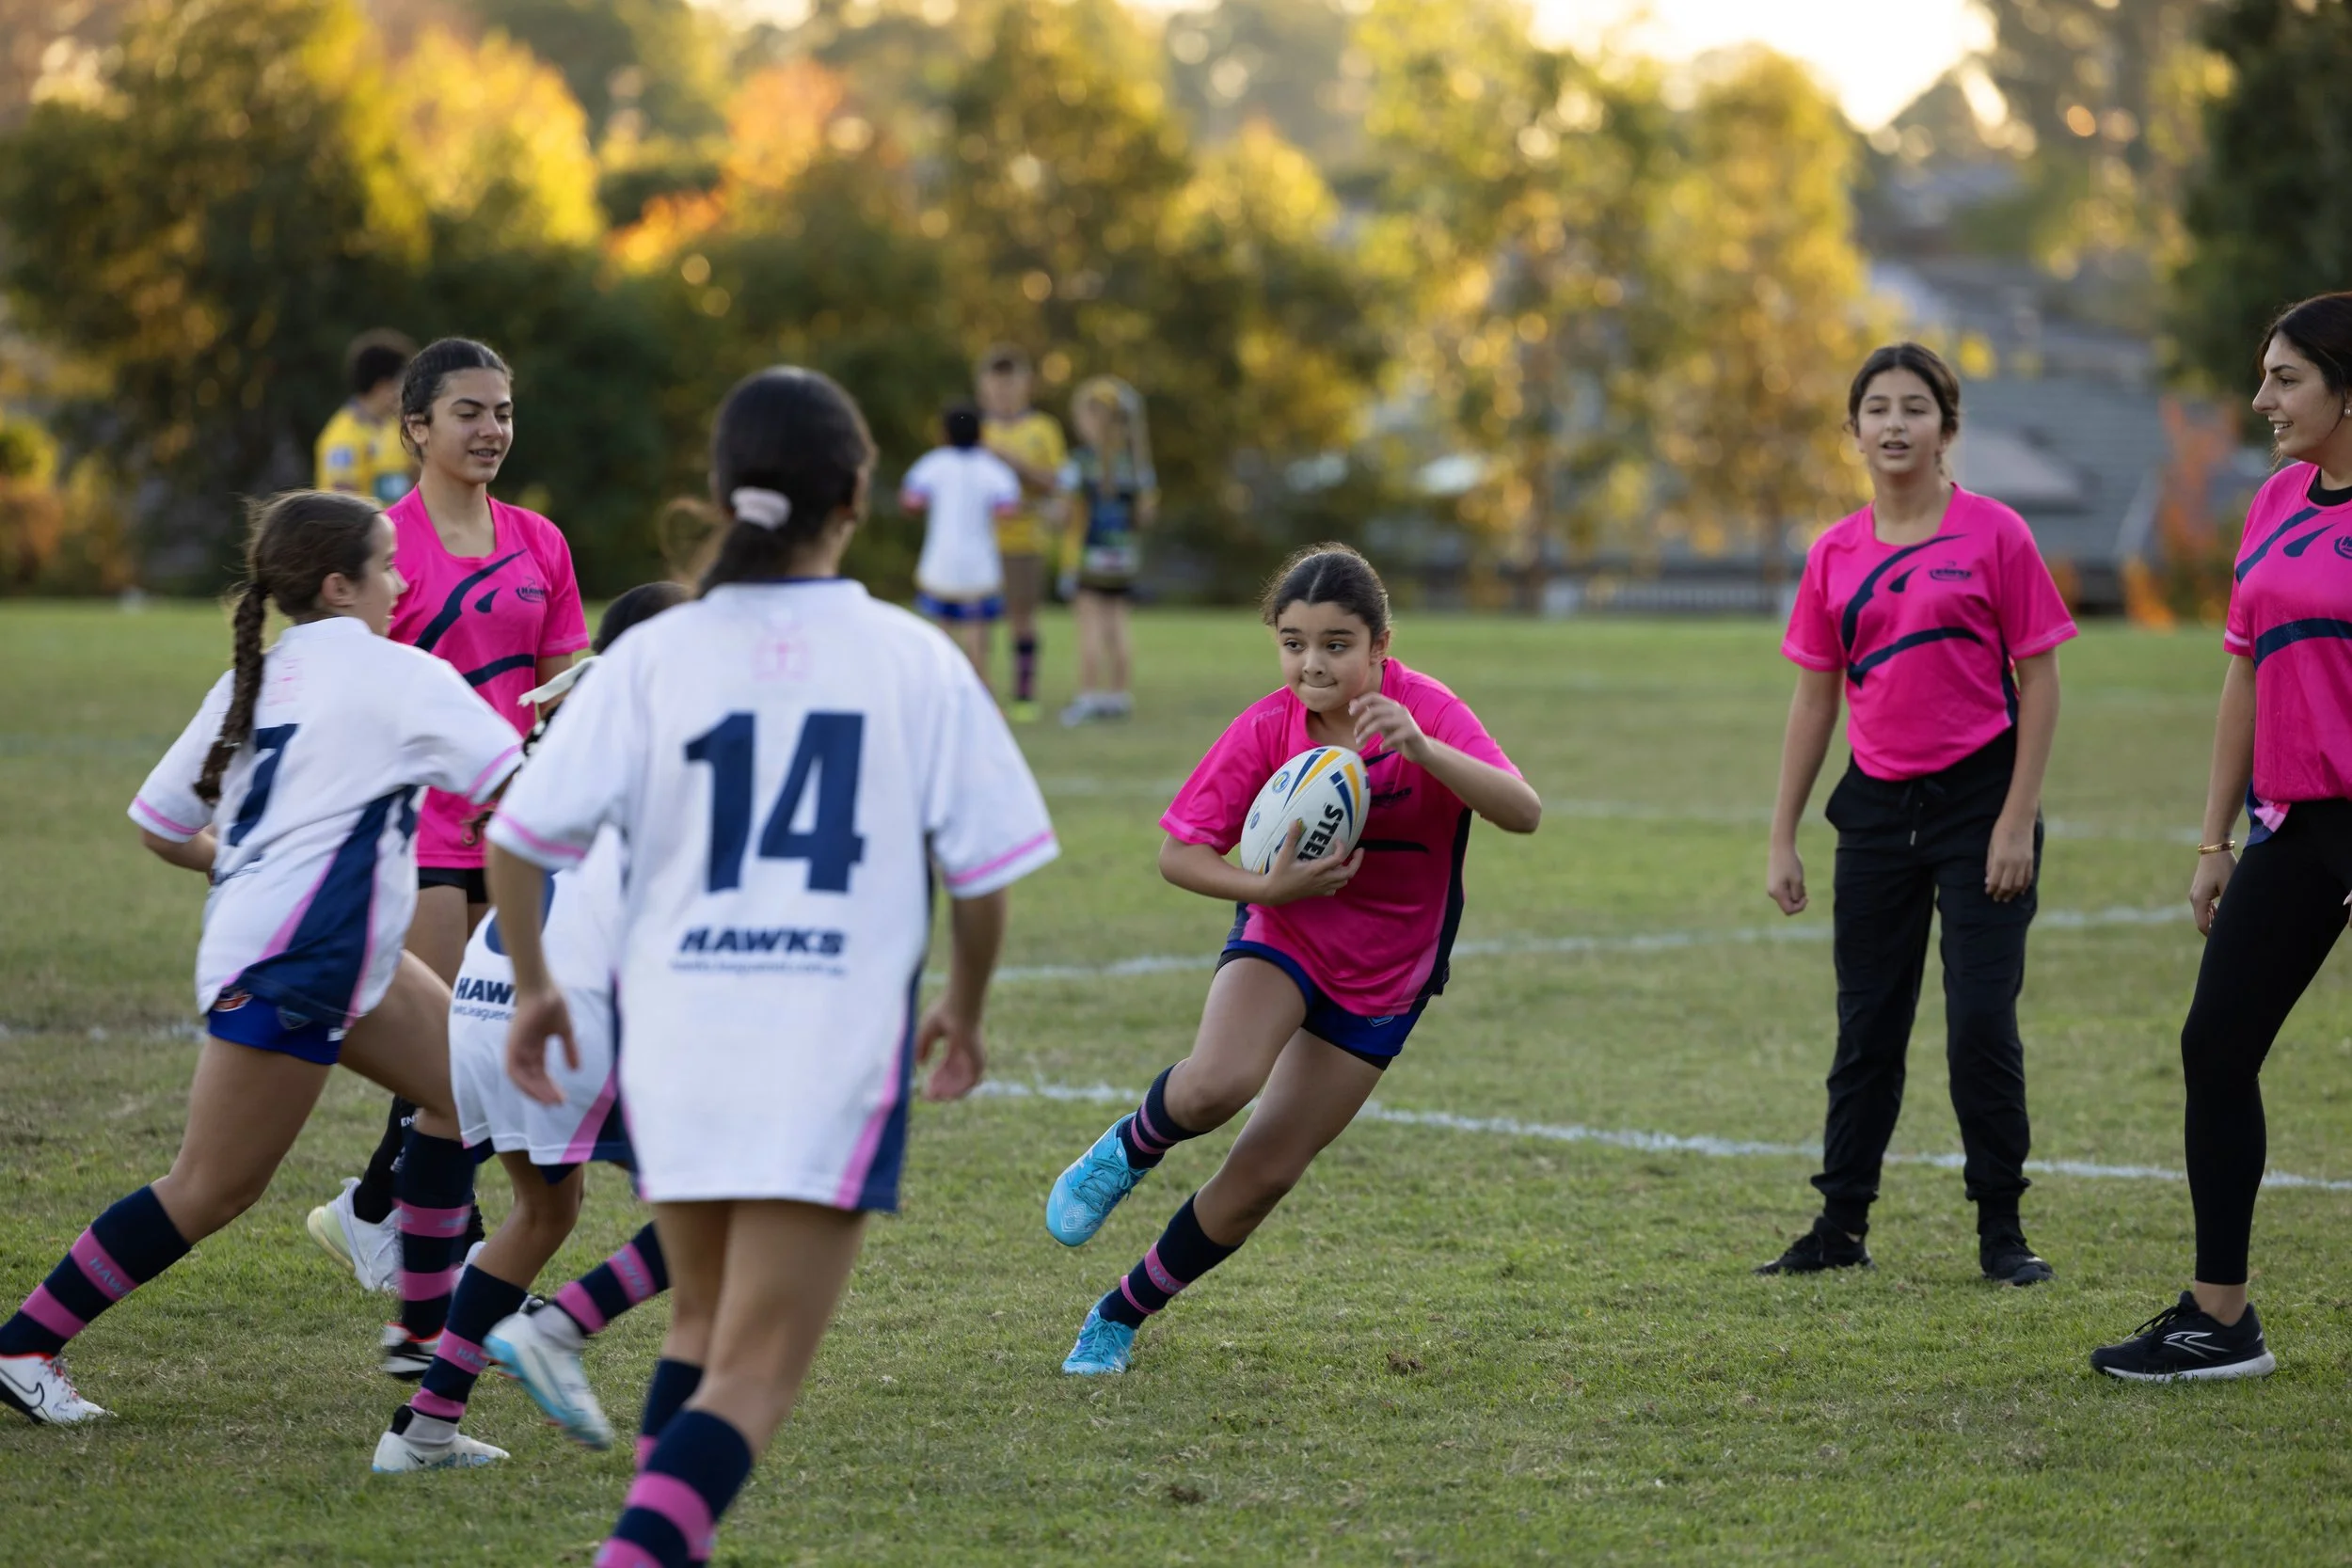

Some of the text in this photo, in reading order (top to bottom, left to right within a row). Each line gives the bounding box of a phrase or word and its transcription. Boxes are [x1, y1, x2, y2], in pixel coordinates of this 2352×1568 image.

[229, 723, 300, 847] 7
[685, 712, 865, 893] 14
[680, 927, 845, 955] HAWKS
[455, 977, 516, 1006] HAW
[401, 1114, 421, 1127] EN
[1151, 1264, 1182, 1291] HAW
[457, 1347, 488, 1369] HAW
